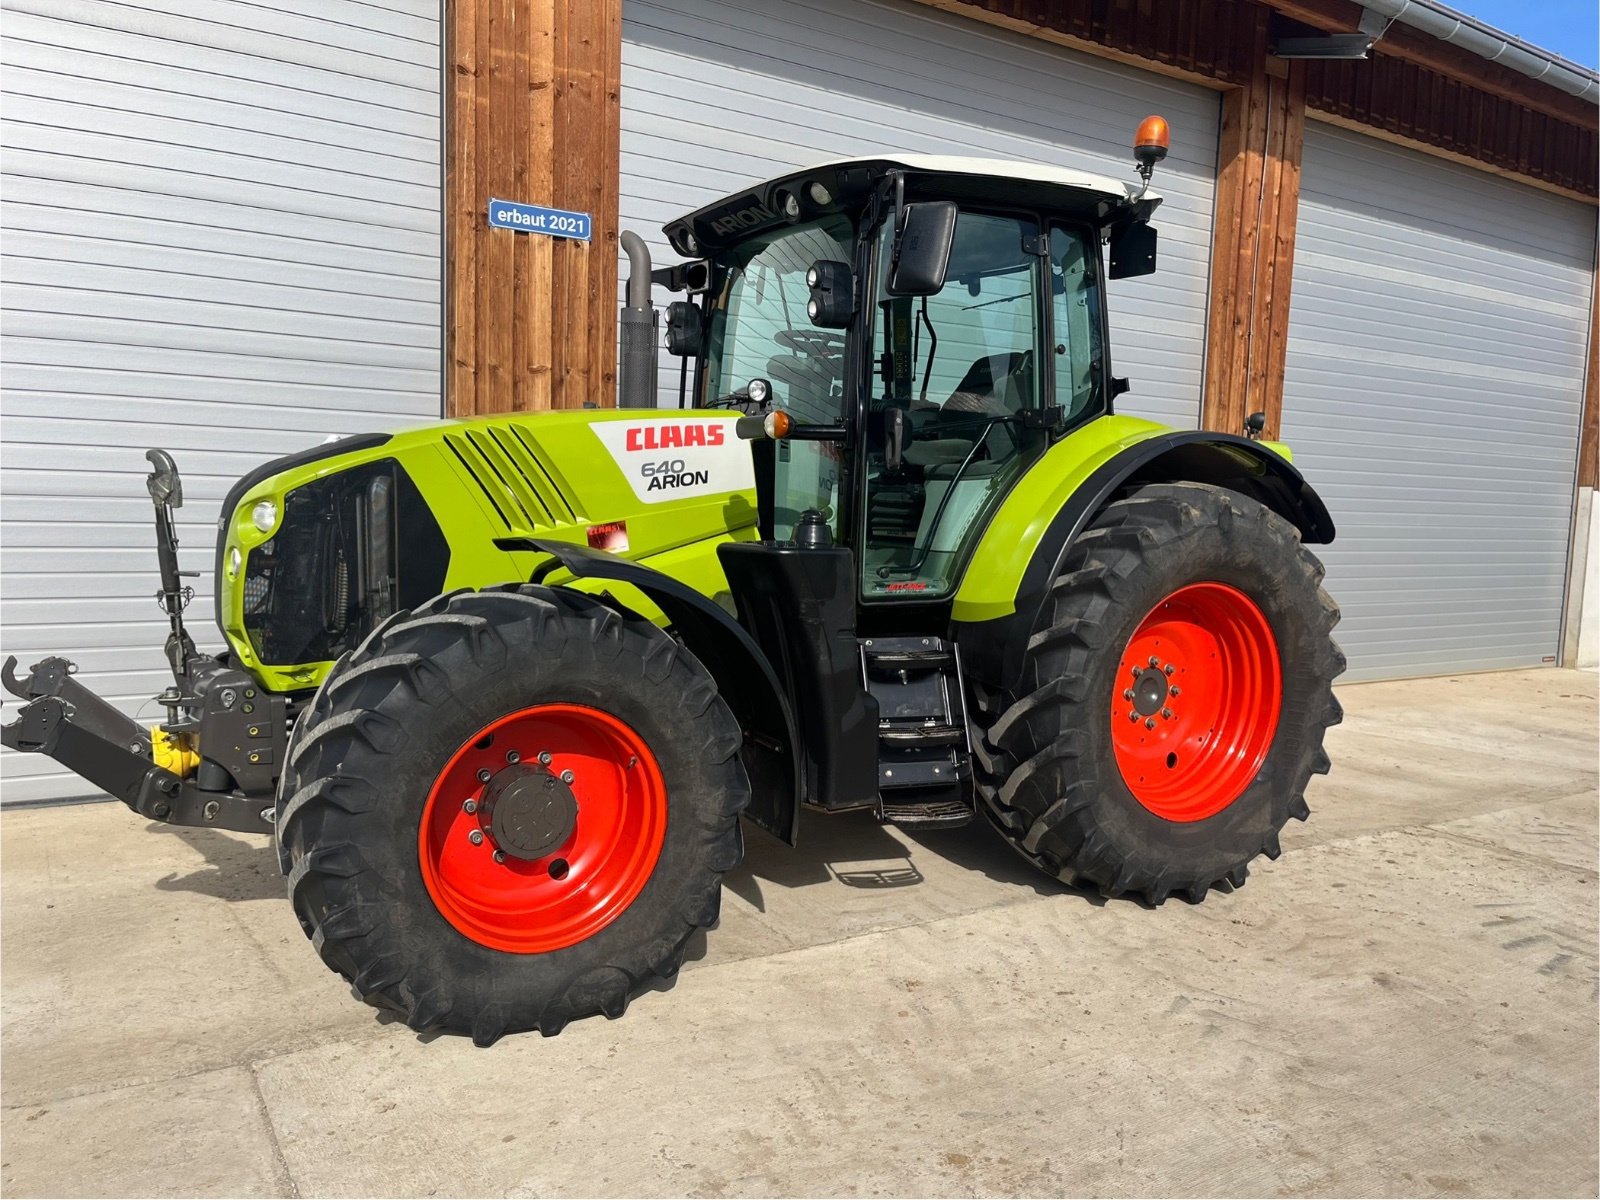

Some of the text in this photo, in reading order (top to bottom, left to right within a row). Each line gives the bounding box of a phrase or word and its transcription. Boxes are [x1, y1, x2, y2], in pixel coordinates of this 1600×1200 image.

[497, 208, 584, 234] erbaut 2021
[710, 203, 778, 237] ARION
[626, 424, 724, 452] CLAAS
[641, 459, 685, 478] 640
[647, 470, 709, 492] ARION
